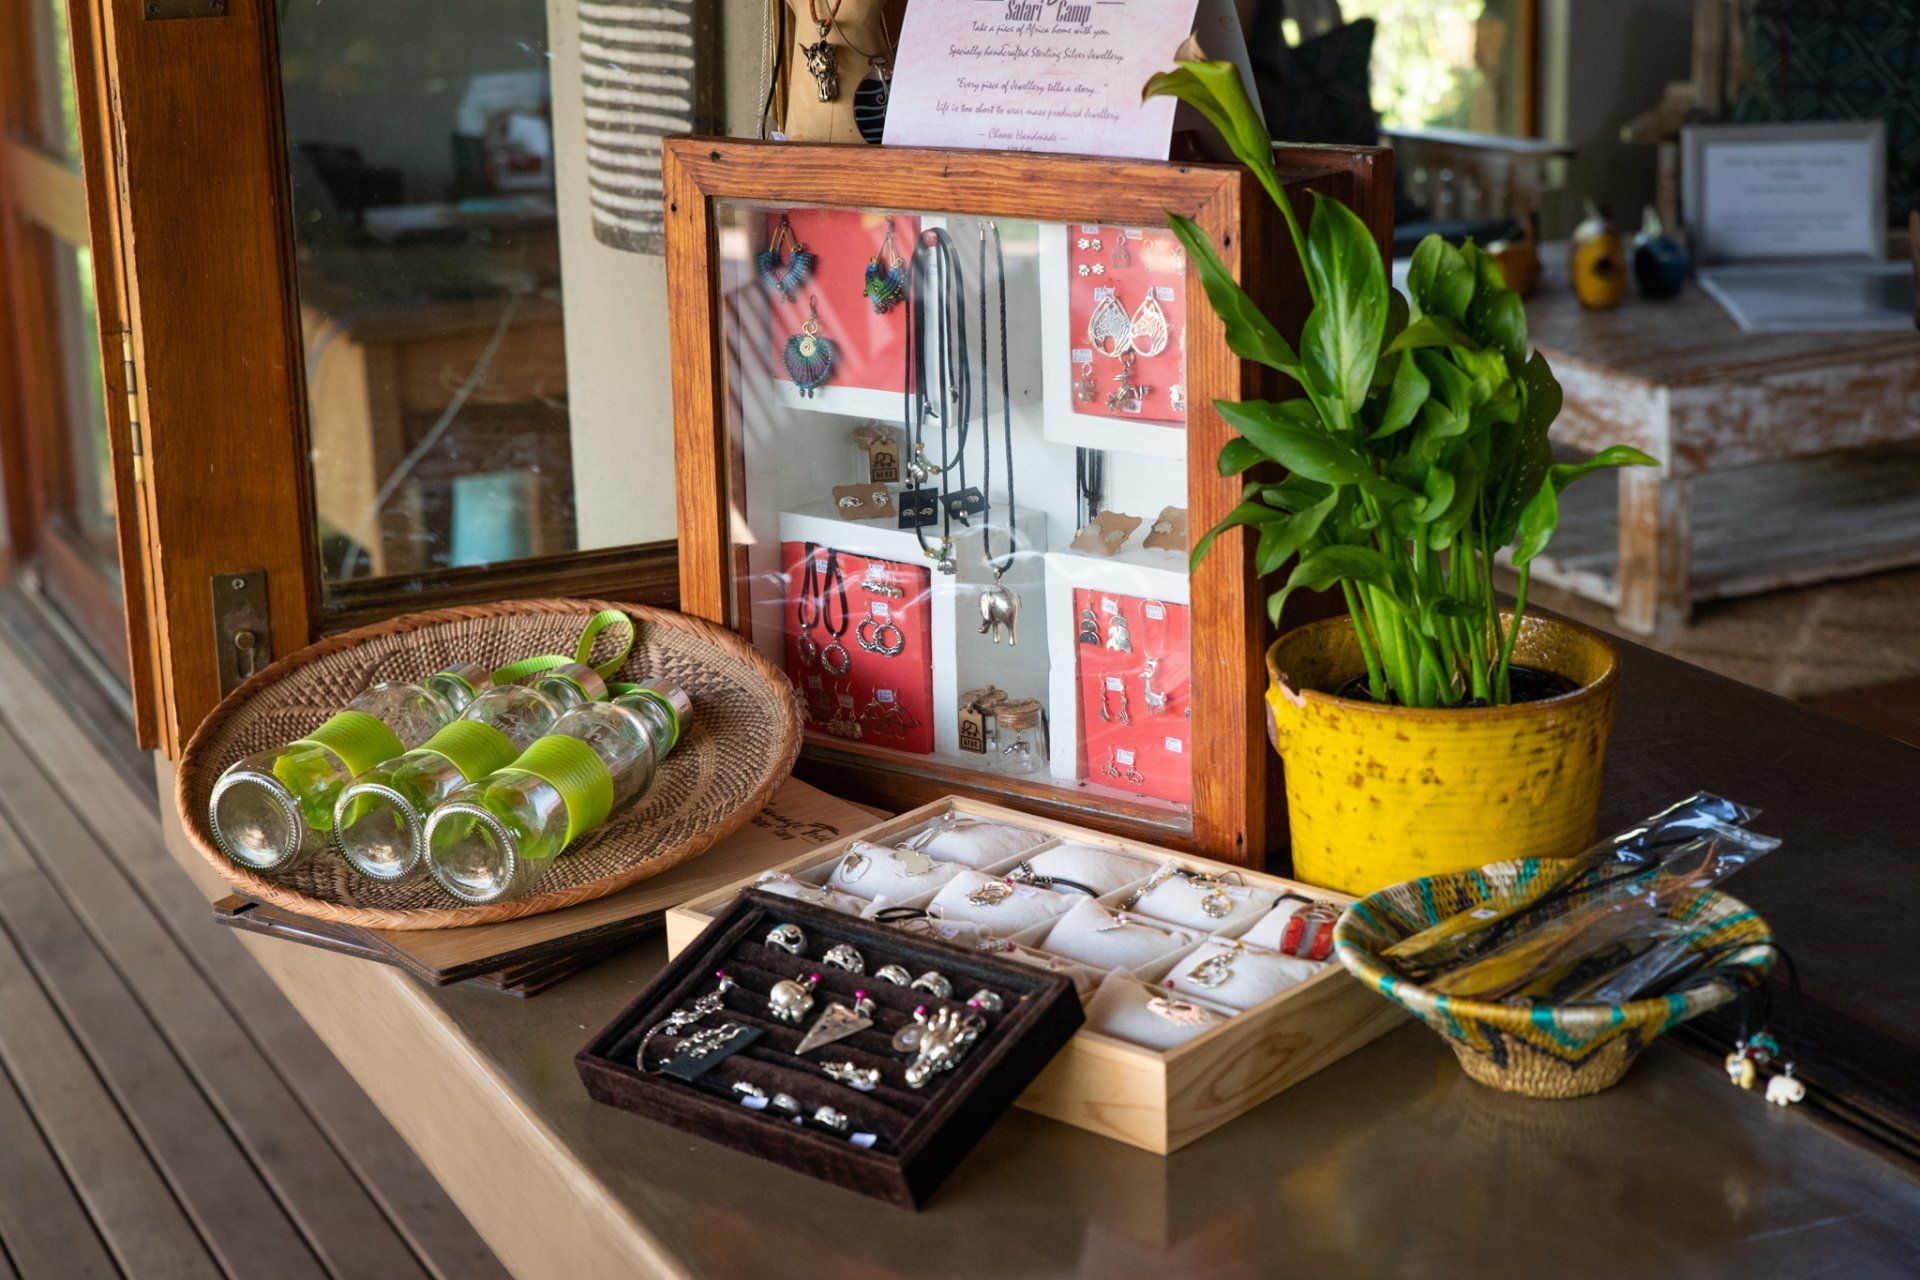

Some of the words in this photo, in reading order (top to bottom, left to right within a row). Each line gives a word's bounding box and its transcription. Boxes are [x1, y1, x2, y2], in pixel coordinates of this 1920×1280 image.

[1005, 0, 1043, 21] Safari
[1056, 0, 1091, 26] Camp
[973, 21, 987, 32] Take
[996, 25, 1014, 35] piece
[1016, 23, 1025, 37] of
[1026, 23, 1049, 37] Africa
[1051, 24, 1072, 34] home
[1074, 25, 1093, 35] with
[949, 44, 982, 59] Specially
[984, 45, 1029, 60] handcrafted
[1030, 47, 1060, 62] Sterling
[1063, 48, 1085, 59] Silver
[981, 81, 998, 92] piece
[1001, 80, 1010, 94] of
[1010, 80, 1044, 94] Jewellery
[1047, 81, 1064, 92] tells
[936, 101, 950, 115] Life
[951, 103, 959, 112] is
[961, 104, 973, 113] too
[975, 103, 994, 114] short
[996, 105, 1004, 114] to
[1026, 109, 1046, 117] mass
[1047, 107, 1082, 120] produced
[1084, 108, 1119, 124] Jewellery
[988, 128, 1014, 140] Choose
[1015, 130, 1057, 141] Handmade
